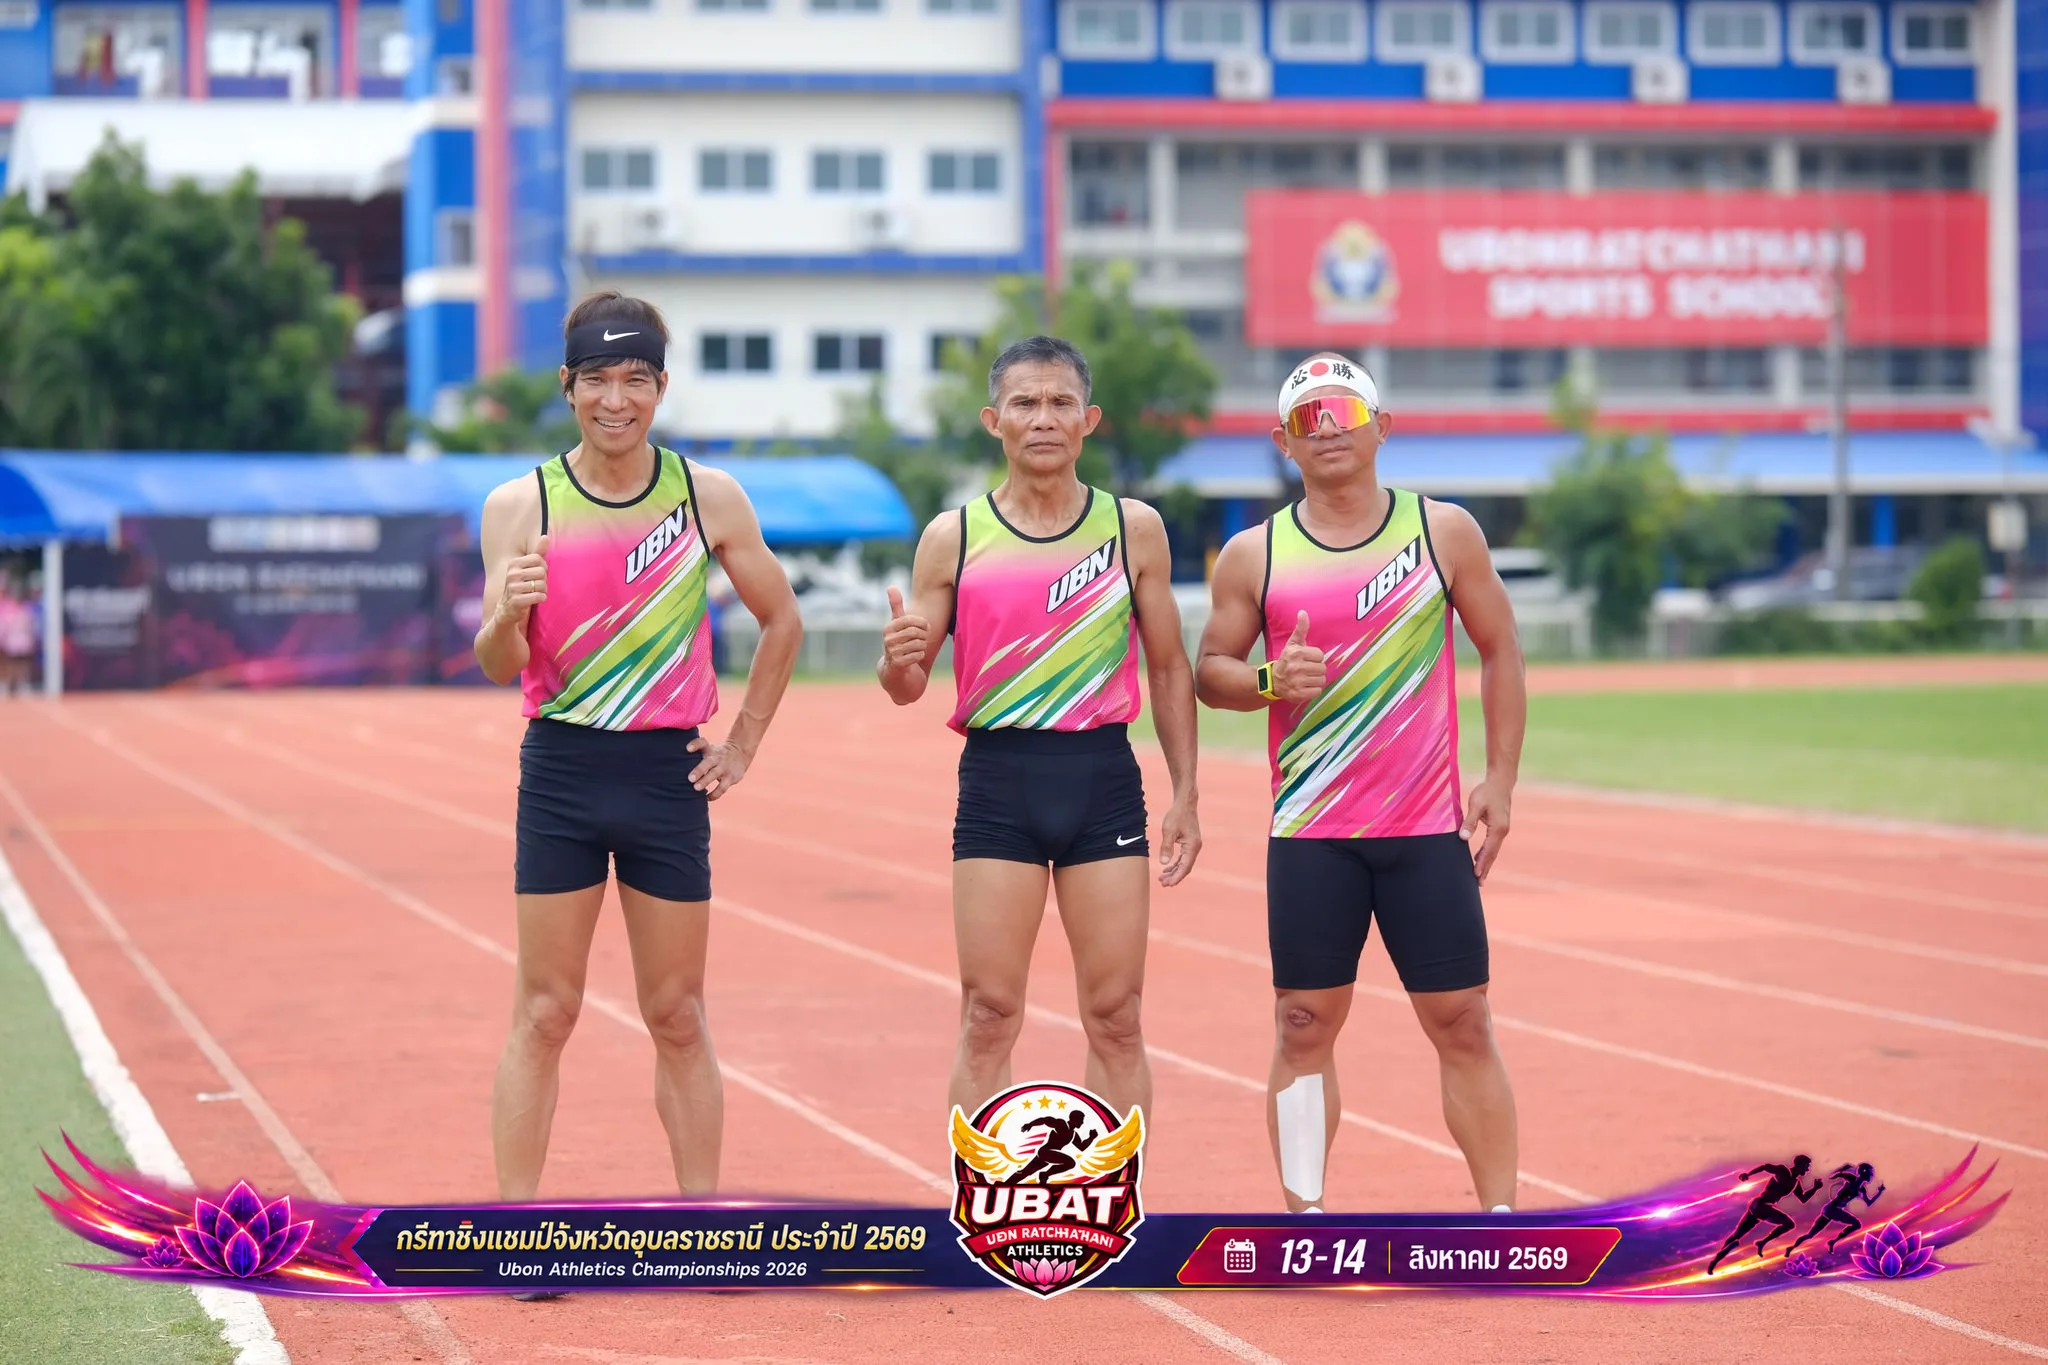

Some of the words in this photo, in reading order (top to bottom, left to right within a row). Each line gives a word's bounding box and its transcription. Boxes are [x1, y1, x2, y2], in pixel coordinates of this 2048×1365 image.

[1489, 275, 1654, 319] SPORTS
[1668, 275, 1836, 320] SCHOOL
[626, 500, 687, 584] UBN
[1047, 537, 1116, 613] UBN
[1357, 537, 1420, 620] UBN
